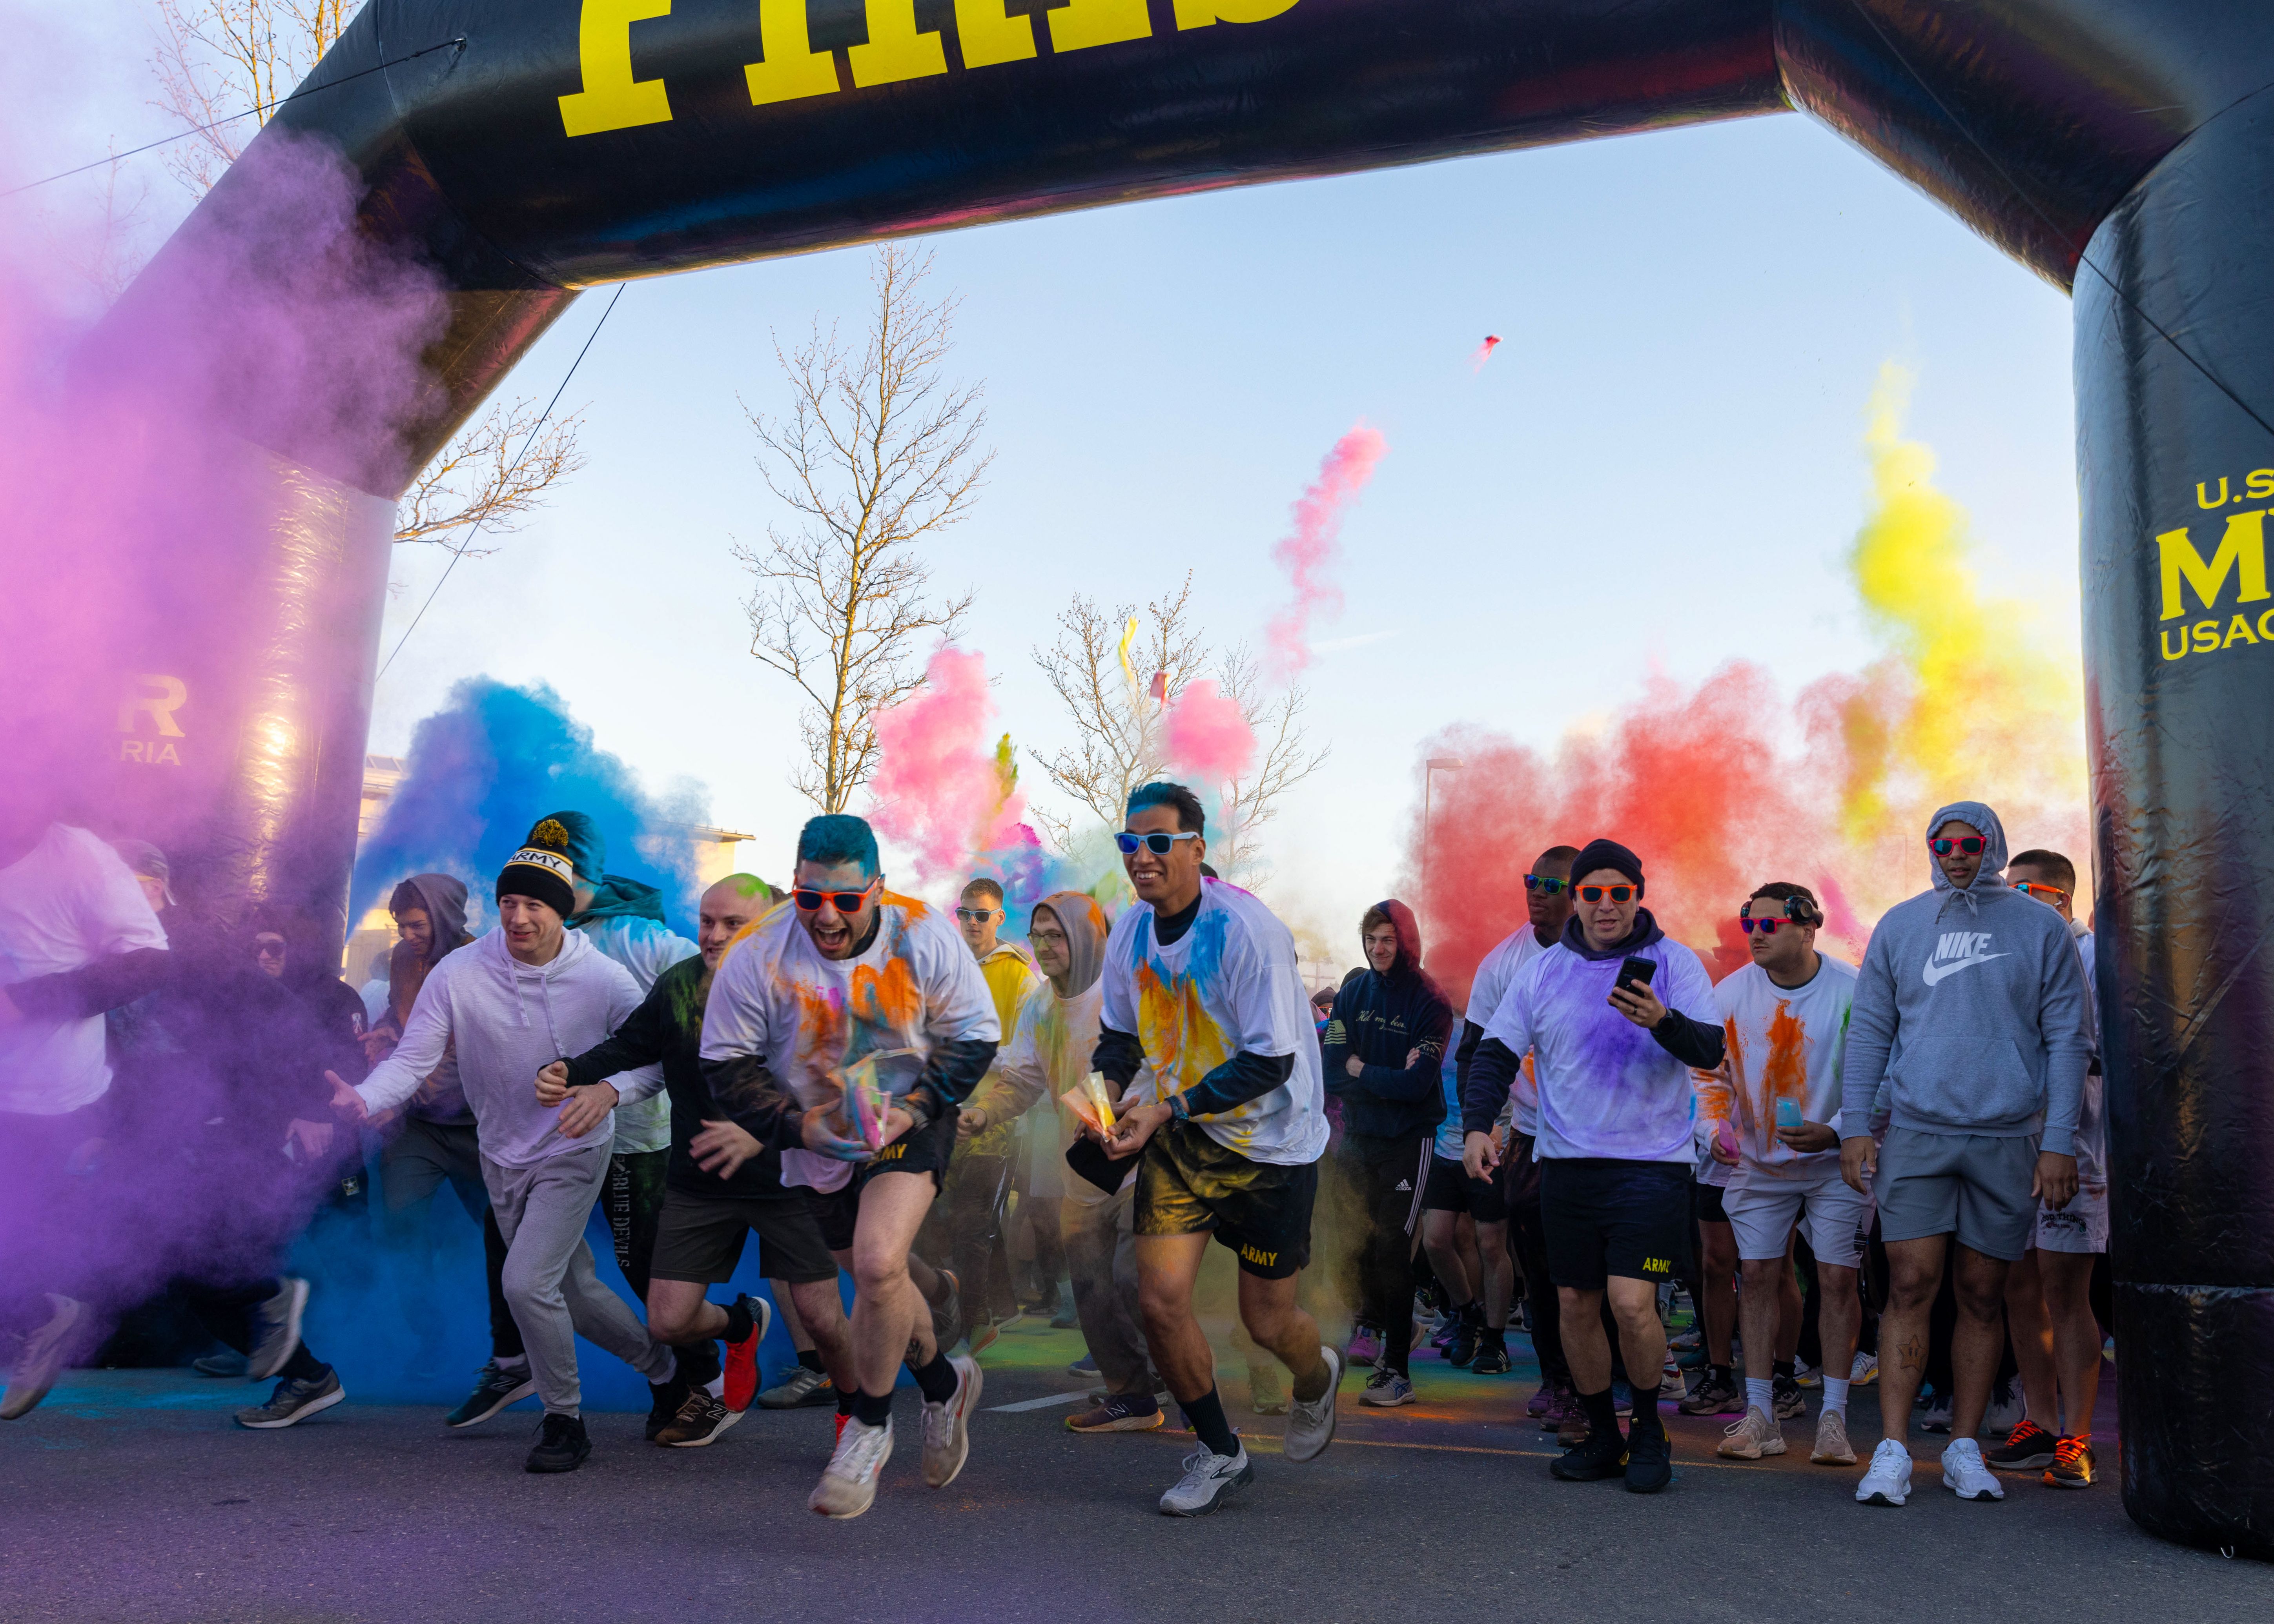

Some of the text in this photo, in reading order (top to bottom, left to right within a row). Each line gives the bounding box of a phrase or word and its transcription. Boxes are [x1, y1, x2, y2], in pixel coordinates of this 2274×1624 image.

[2156, 509, 2274, 621] M
[1934, 932, 1992, 962] NIKE
[1241, 1243, 1278, 1266] ARMY
[1642, 1257, 1671, 1273] ARMY
